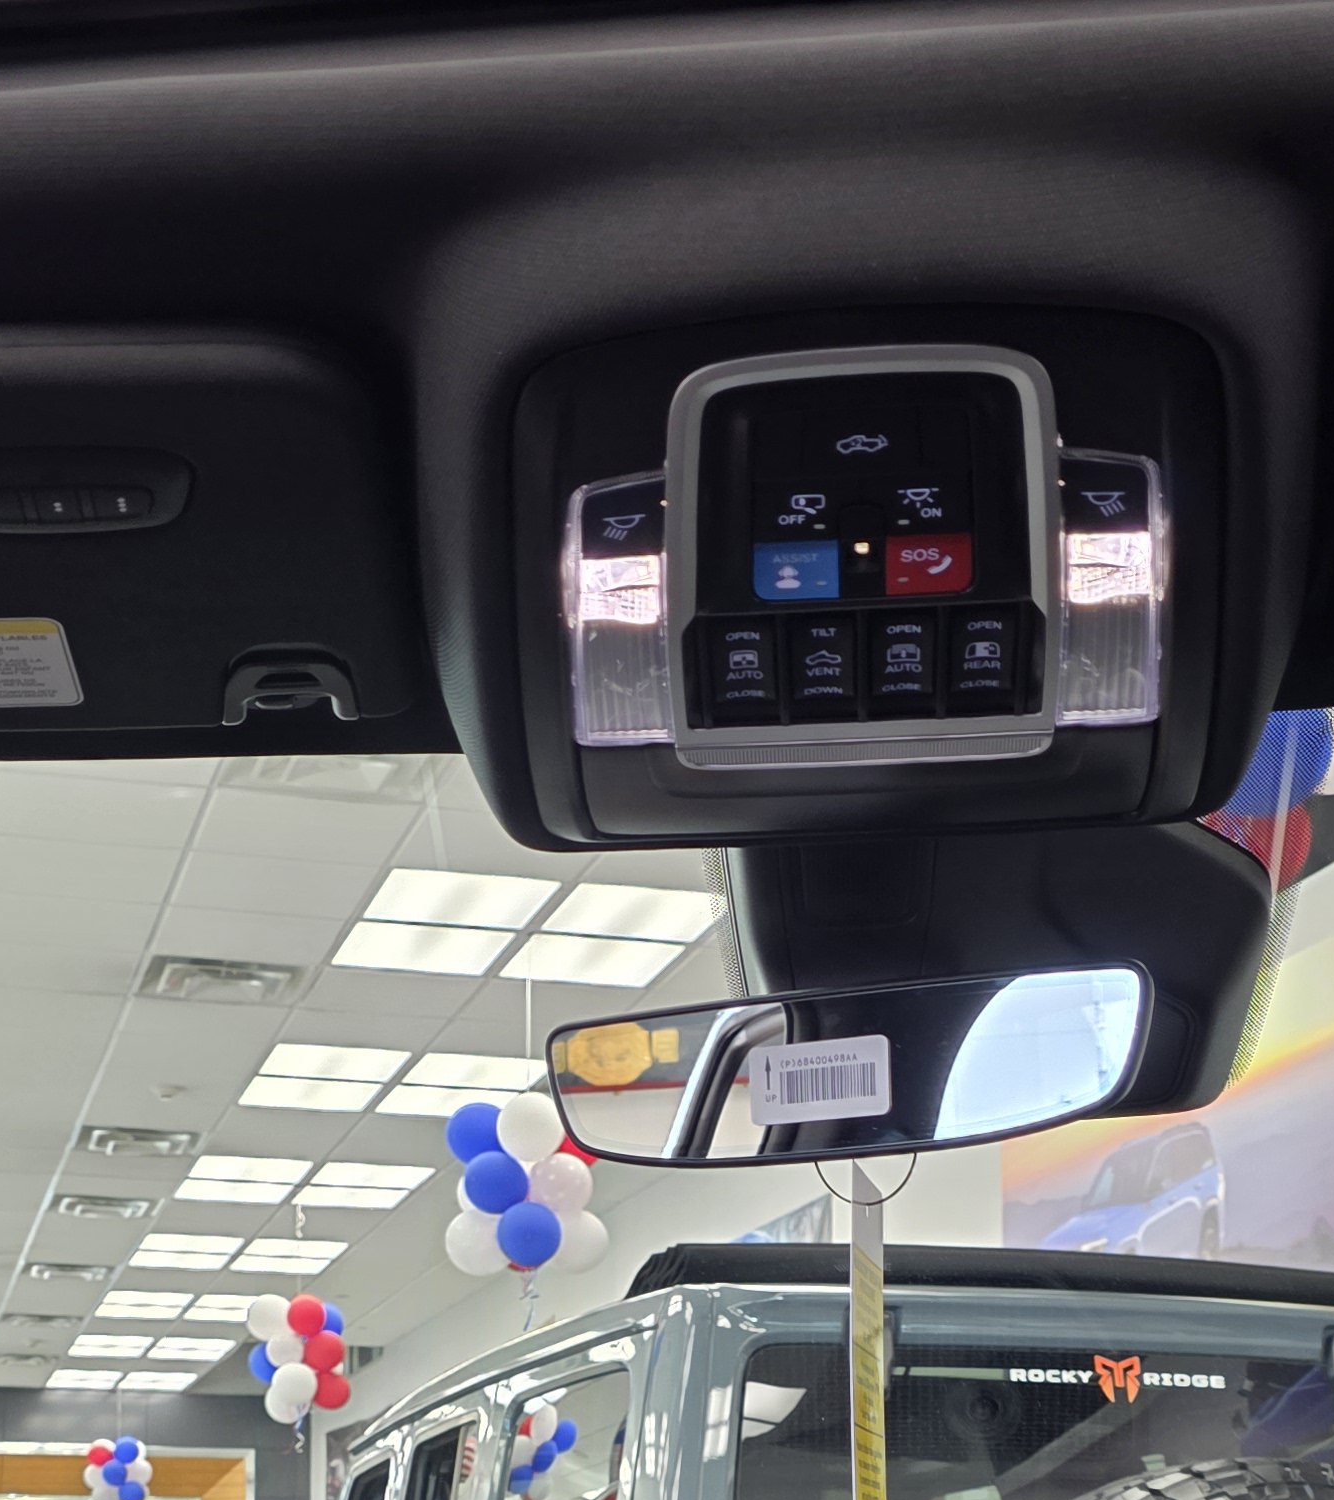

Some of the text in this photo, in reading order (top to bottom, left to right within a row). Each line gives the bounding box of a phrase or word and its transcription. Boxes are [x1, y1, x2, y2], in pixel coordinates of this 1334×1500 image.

[920, 507, 942, 518] ON
[778, 514, 806, 525] OFF
[772, 553, 819, 563] ASSIST
[900, 547, 939, 562] SOS
[886, 624, 922, 635] OPEN
[967, 620, 1002, 631] OPEN
[726, 631, 760, 641] OPEN
[810, 627, 837, 637] TILT
[885, 662, 922, 674] AUTO
[963, 659, 1001, 670] REAR
[726, 670, 764, 680] AUTO
[806, 666, 841, 677] VENT
[804, 685, 843, 695] DOWN
[882, 681, 922, 692] CLOSE
[765, 1094, 777, 1103] UP
[1009, 1367, 1226, 1389] ROCKY RIDGE
